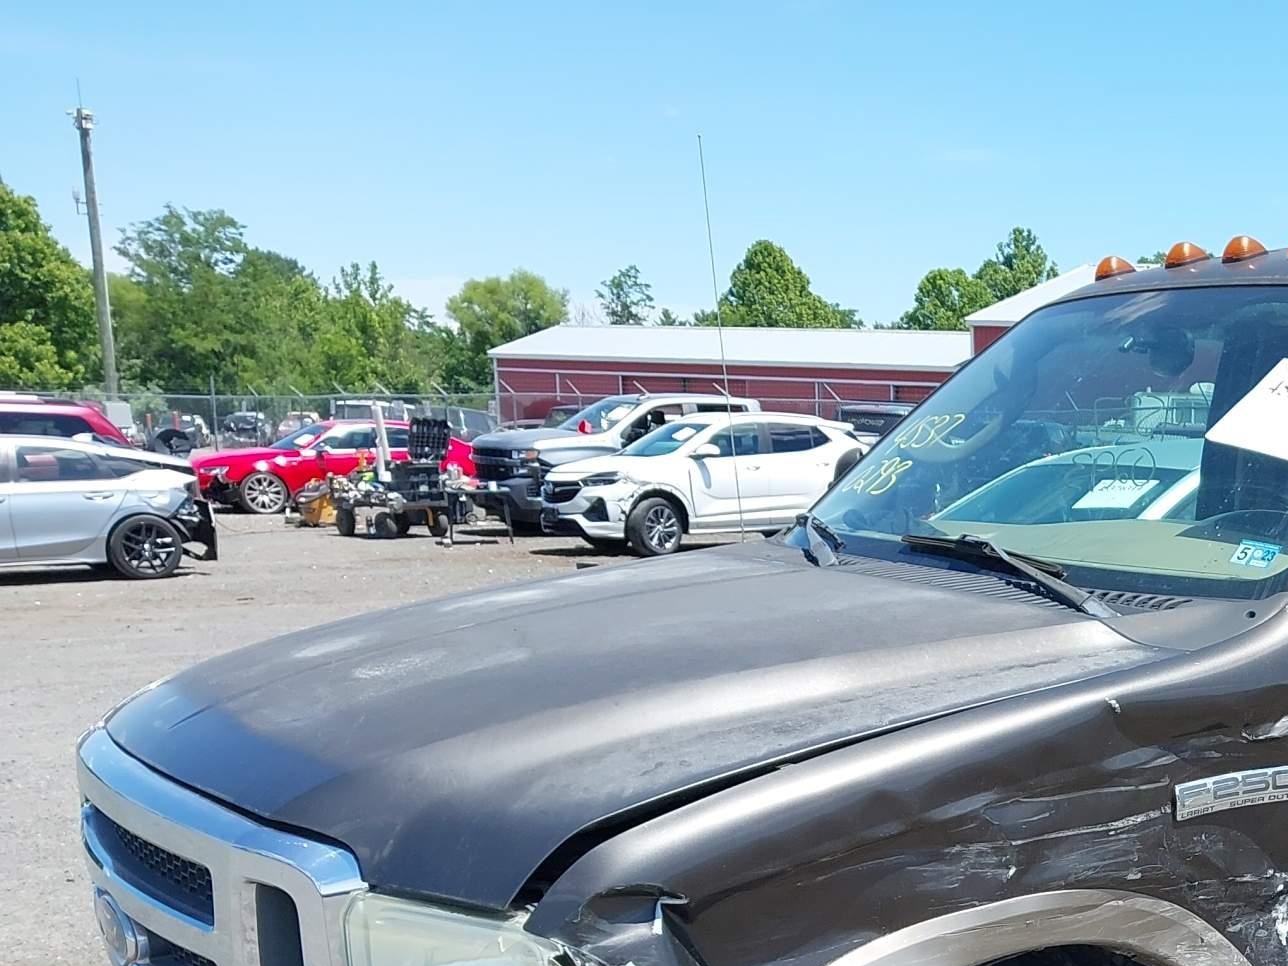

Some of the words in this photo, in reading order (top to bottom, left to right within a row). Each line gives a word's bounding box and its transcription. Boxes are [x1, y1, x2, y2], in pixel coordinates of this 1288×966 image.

[1236, 546, 1251, 561] 5
[1260, 549, 1277, 562] 23
[1180, 805, 1216, 819] LARIAT
[1229, 797, 1265, 808] SUPER
